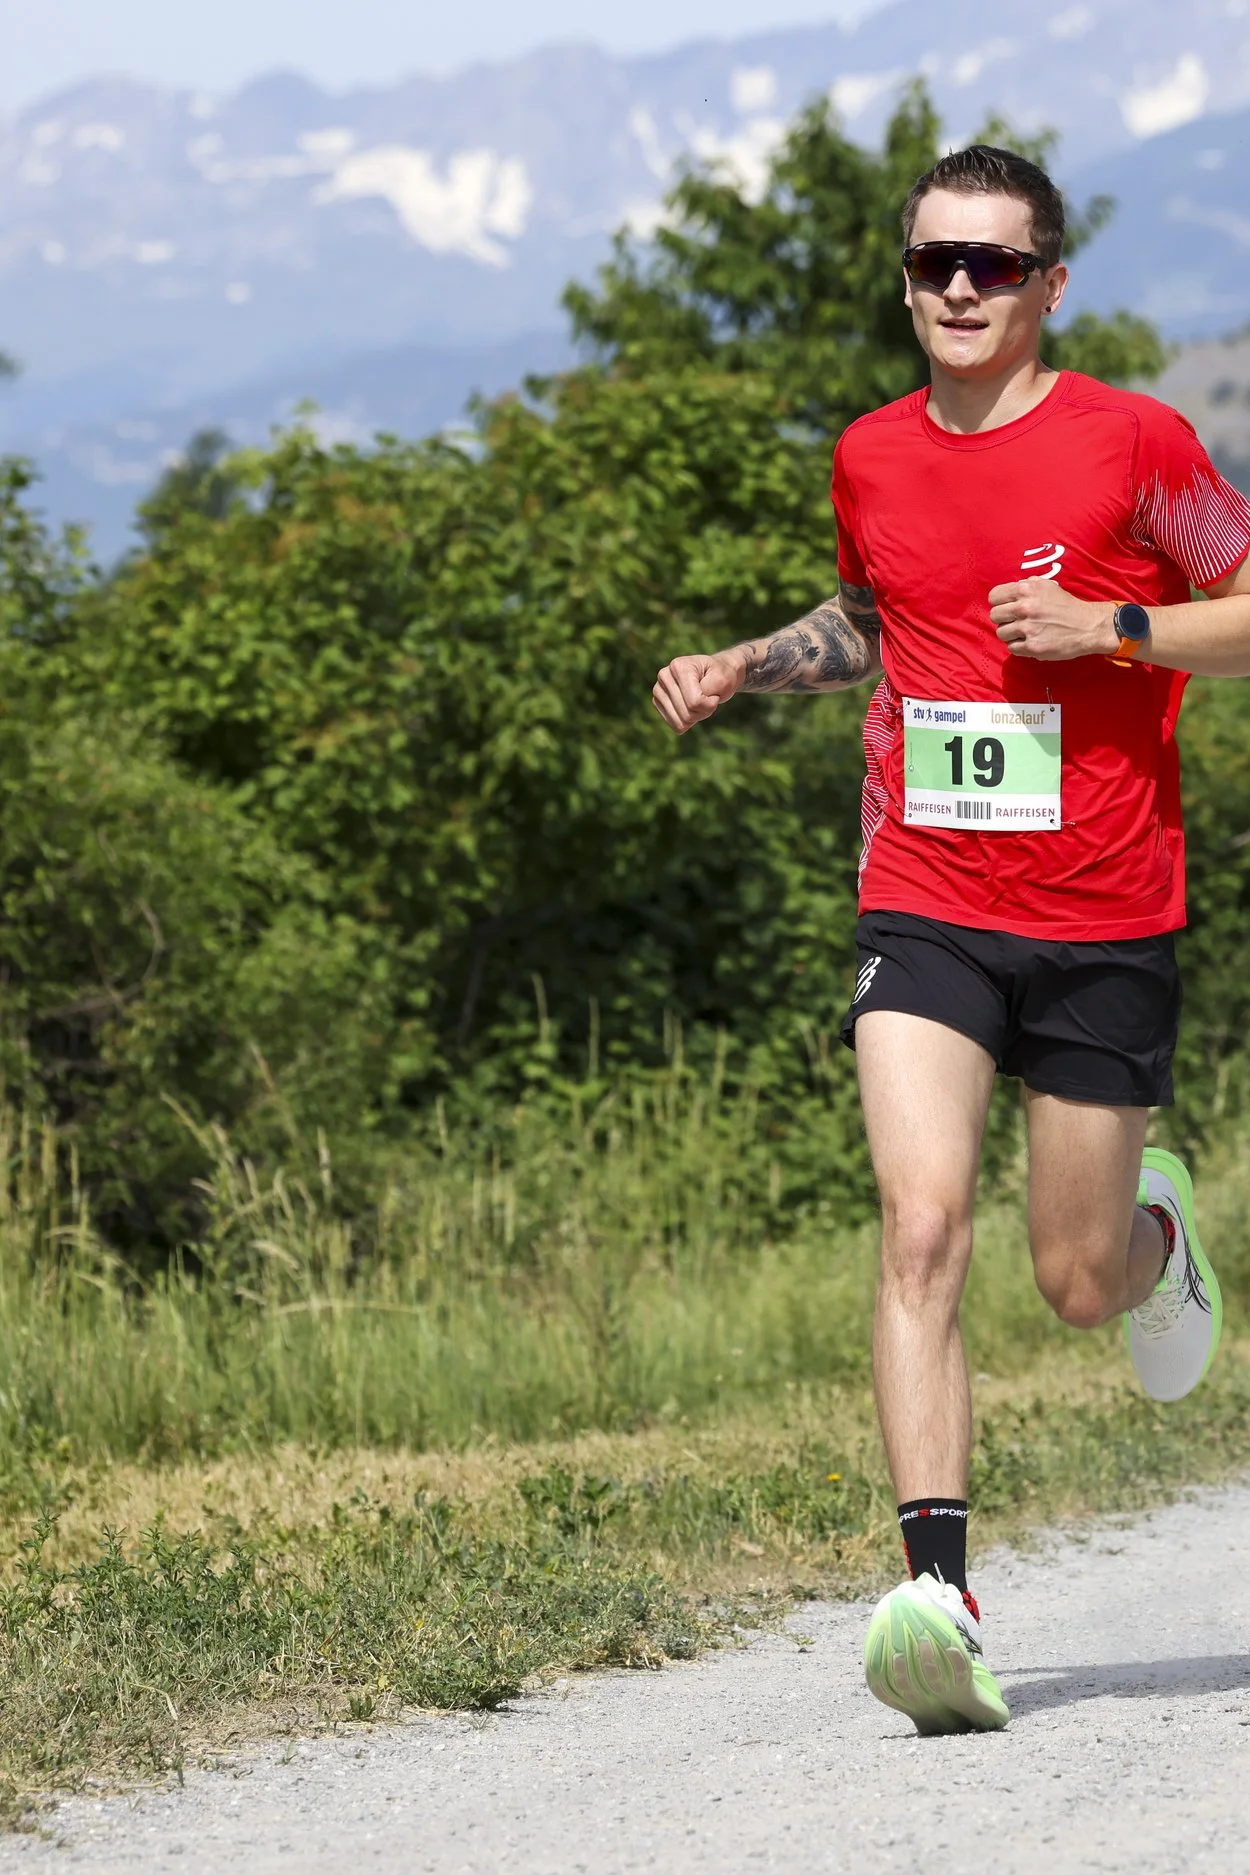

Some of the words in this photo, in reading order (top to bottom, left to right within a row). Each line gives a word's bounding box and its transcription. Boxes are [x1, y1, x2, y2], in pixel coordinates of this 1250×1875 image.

[913, 707, 925, 719] stv
[934, 710, 966, 724] gampel
[991, 709, 1045, 725] lonzalauf
[944, 735, 1005, 787] 19
[908, 801, 952, 815] RAIFFEISEN
[995, 807, 1055, 817] RAIFFEISEN
